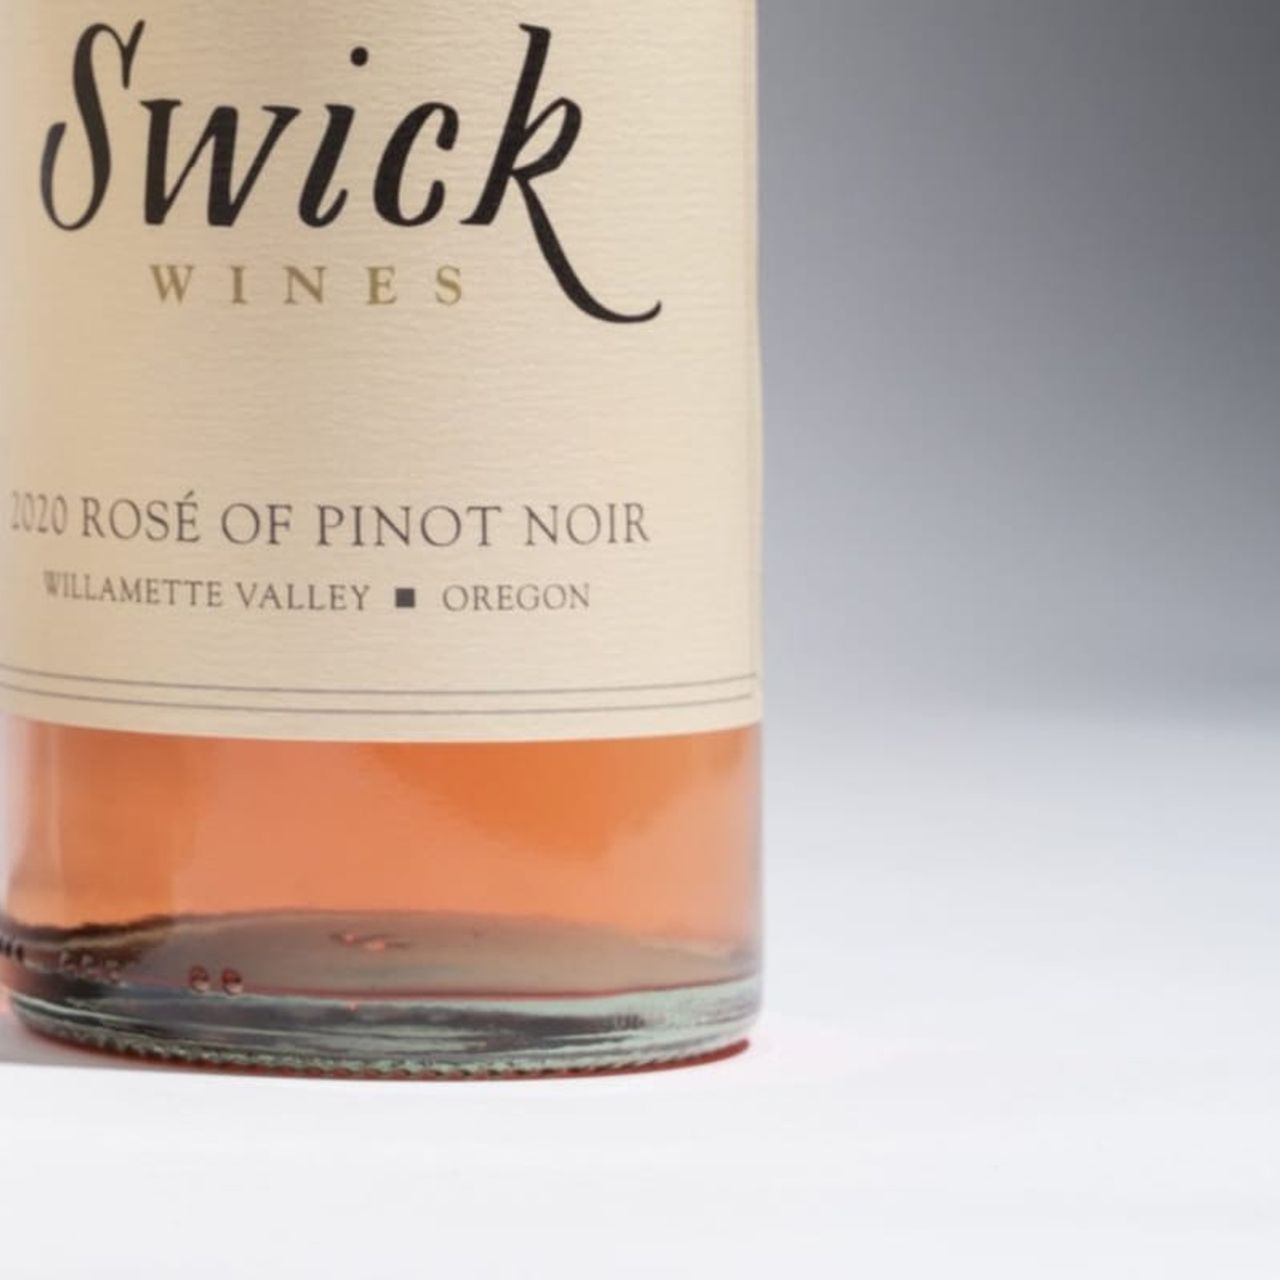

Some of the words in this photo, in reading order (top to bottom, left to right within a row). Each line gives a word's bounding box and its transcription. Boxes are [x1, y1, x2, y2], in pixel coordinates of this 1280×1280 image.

[40, 20, 662, 324] Swick
[150, 264, 464, 306] WINES
[11, 490, 68, 536] 2020
[80, 489, 202, 544] ROSÉ
[221, 501, 293, 546] OF
[316, 504, 502, 548] PINOT
[525, 502, 650, 546] NOIR
[42, 569, 223, 608] WILLAMETTE
[236, 581, 370, 612] VALLEY
[443, 583, 590, 613] OREGON
